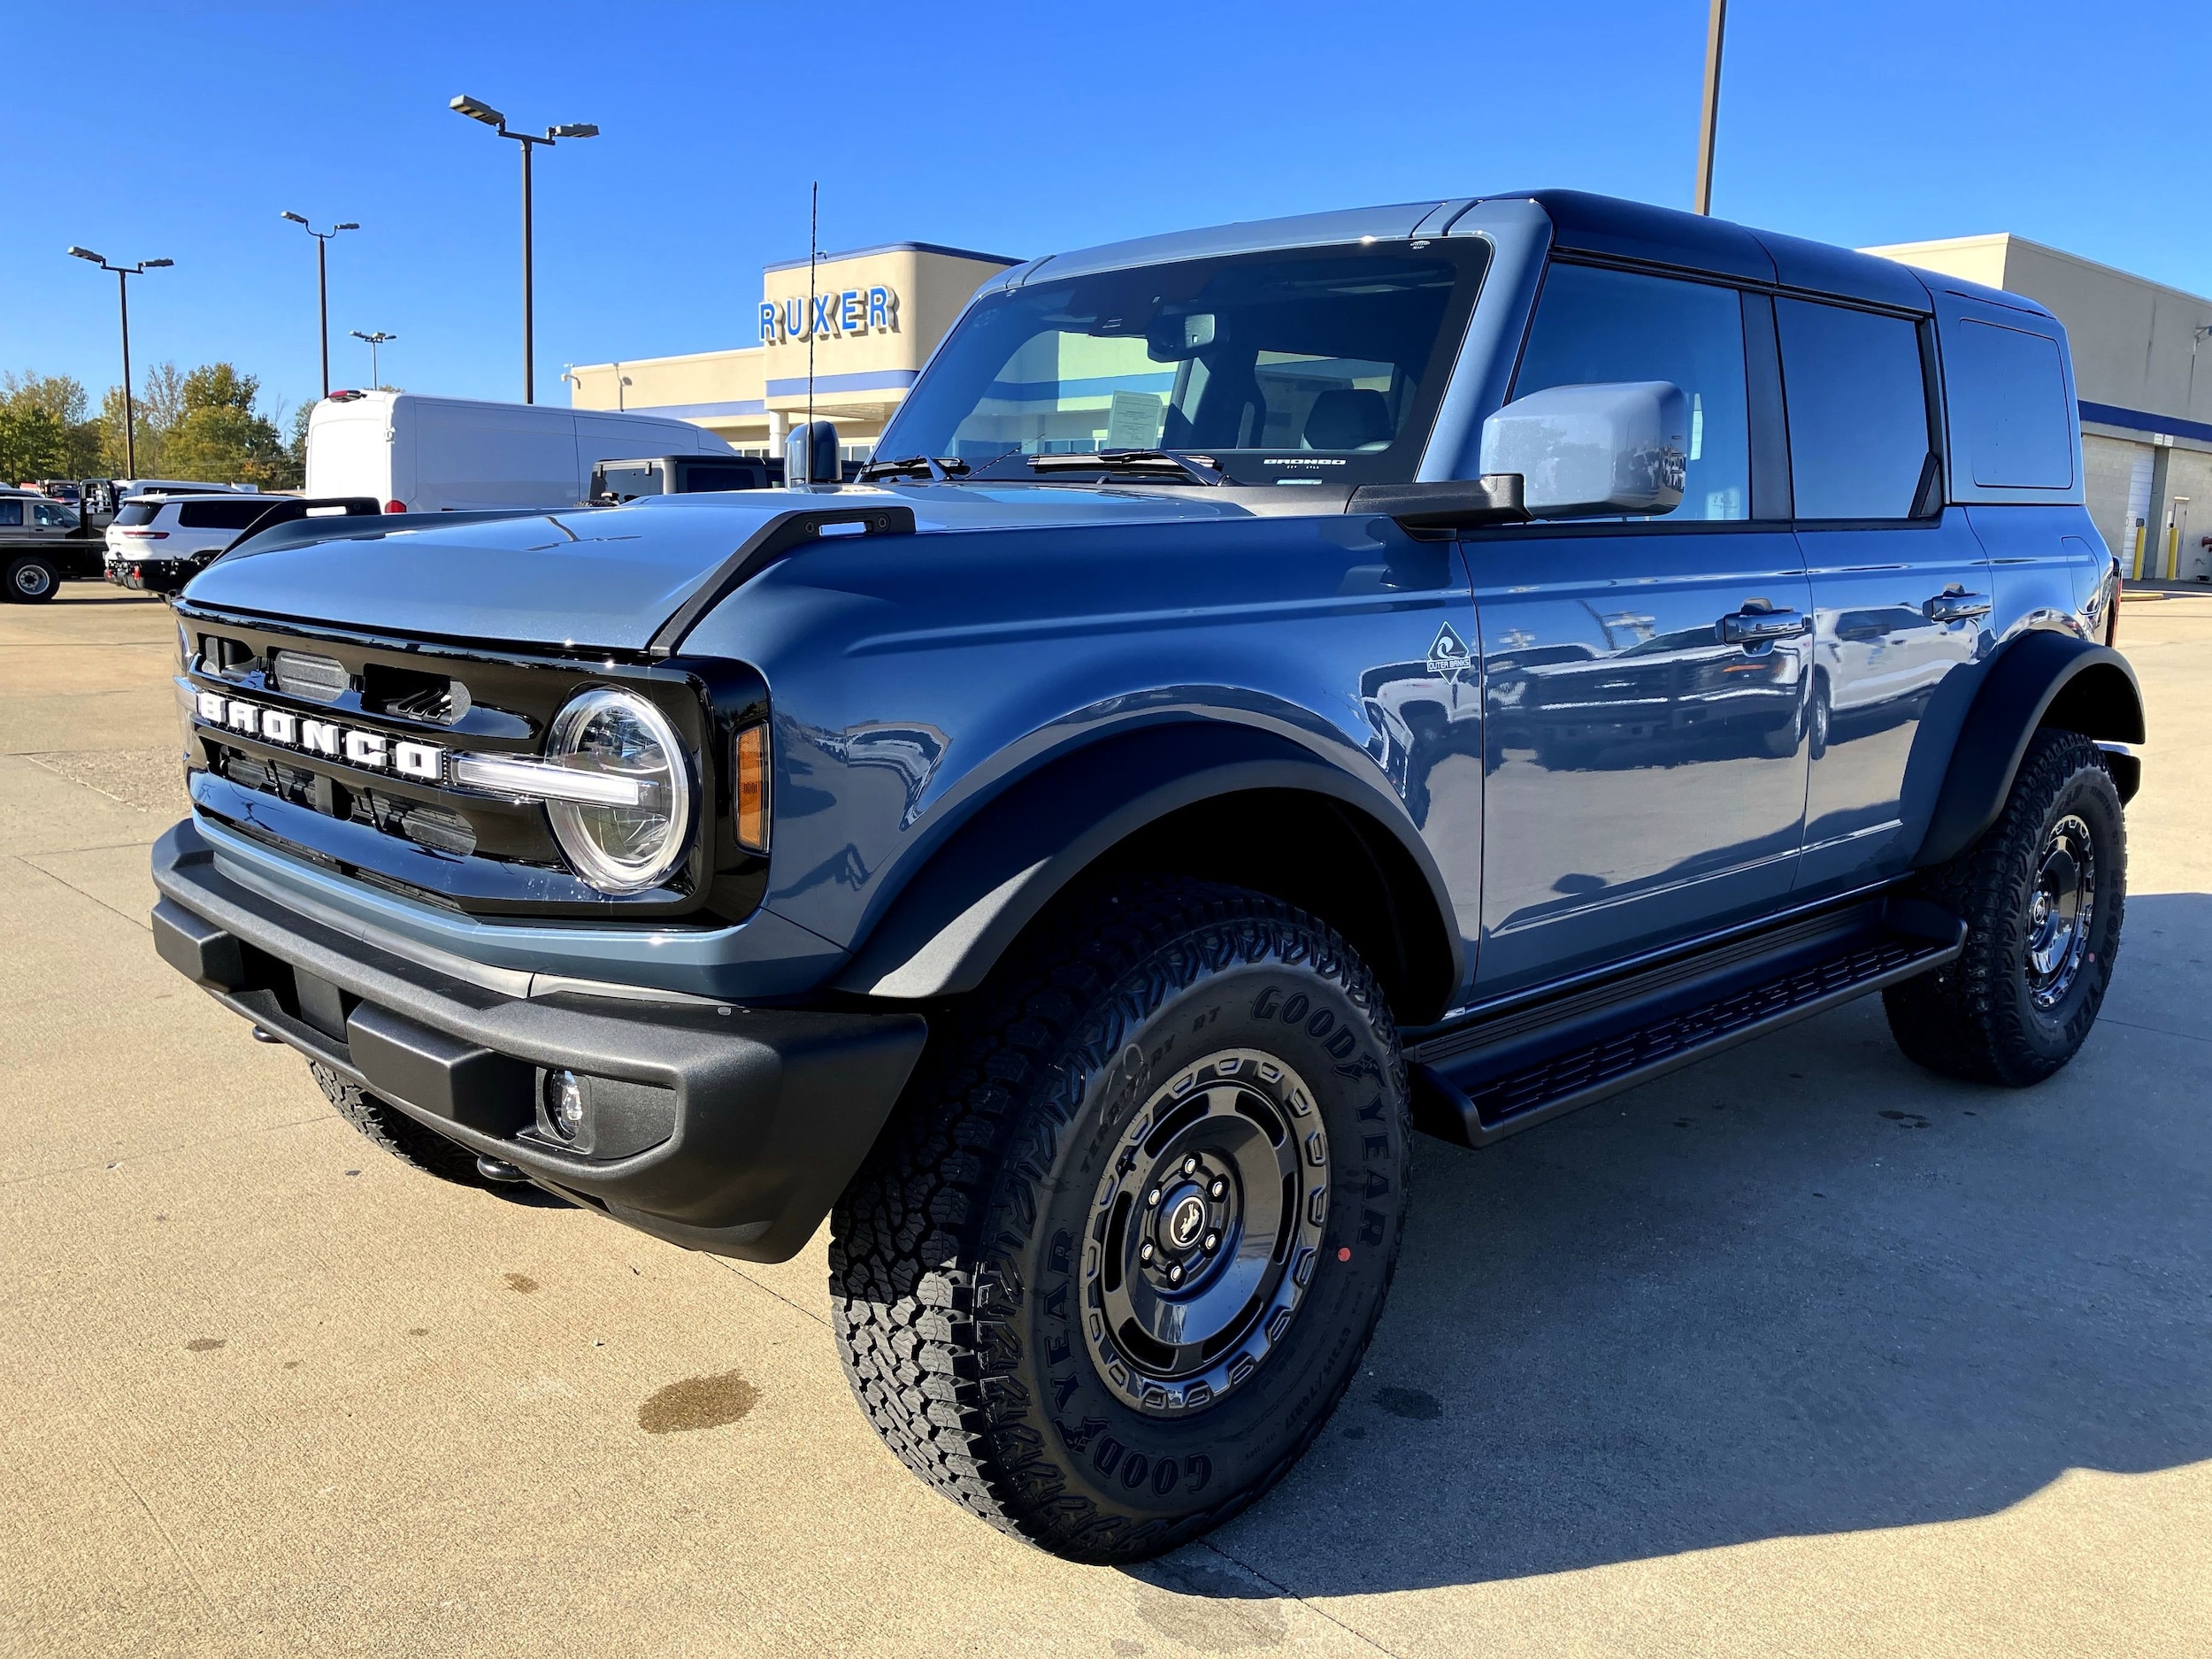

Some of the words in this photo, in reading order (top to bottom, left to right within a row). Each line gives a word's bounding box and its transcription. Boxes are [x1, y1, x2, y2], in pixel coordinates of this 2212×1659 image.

[758, 286, 896, 342] RUXER
[1429, 661, 1449, 670] OUTER
[1449, 658, 1470, 668] BANKS
[199, 692, 443, 780] BRONCO
